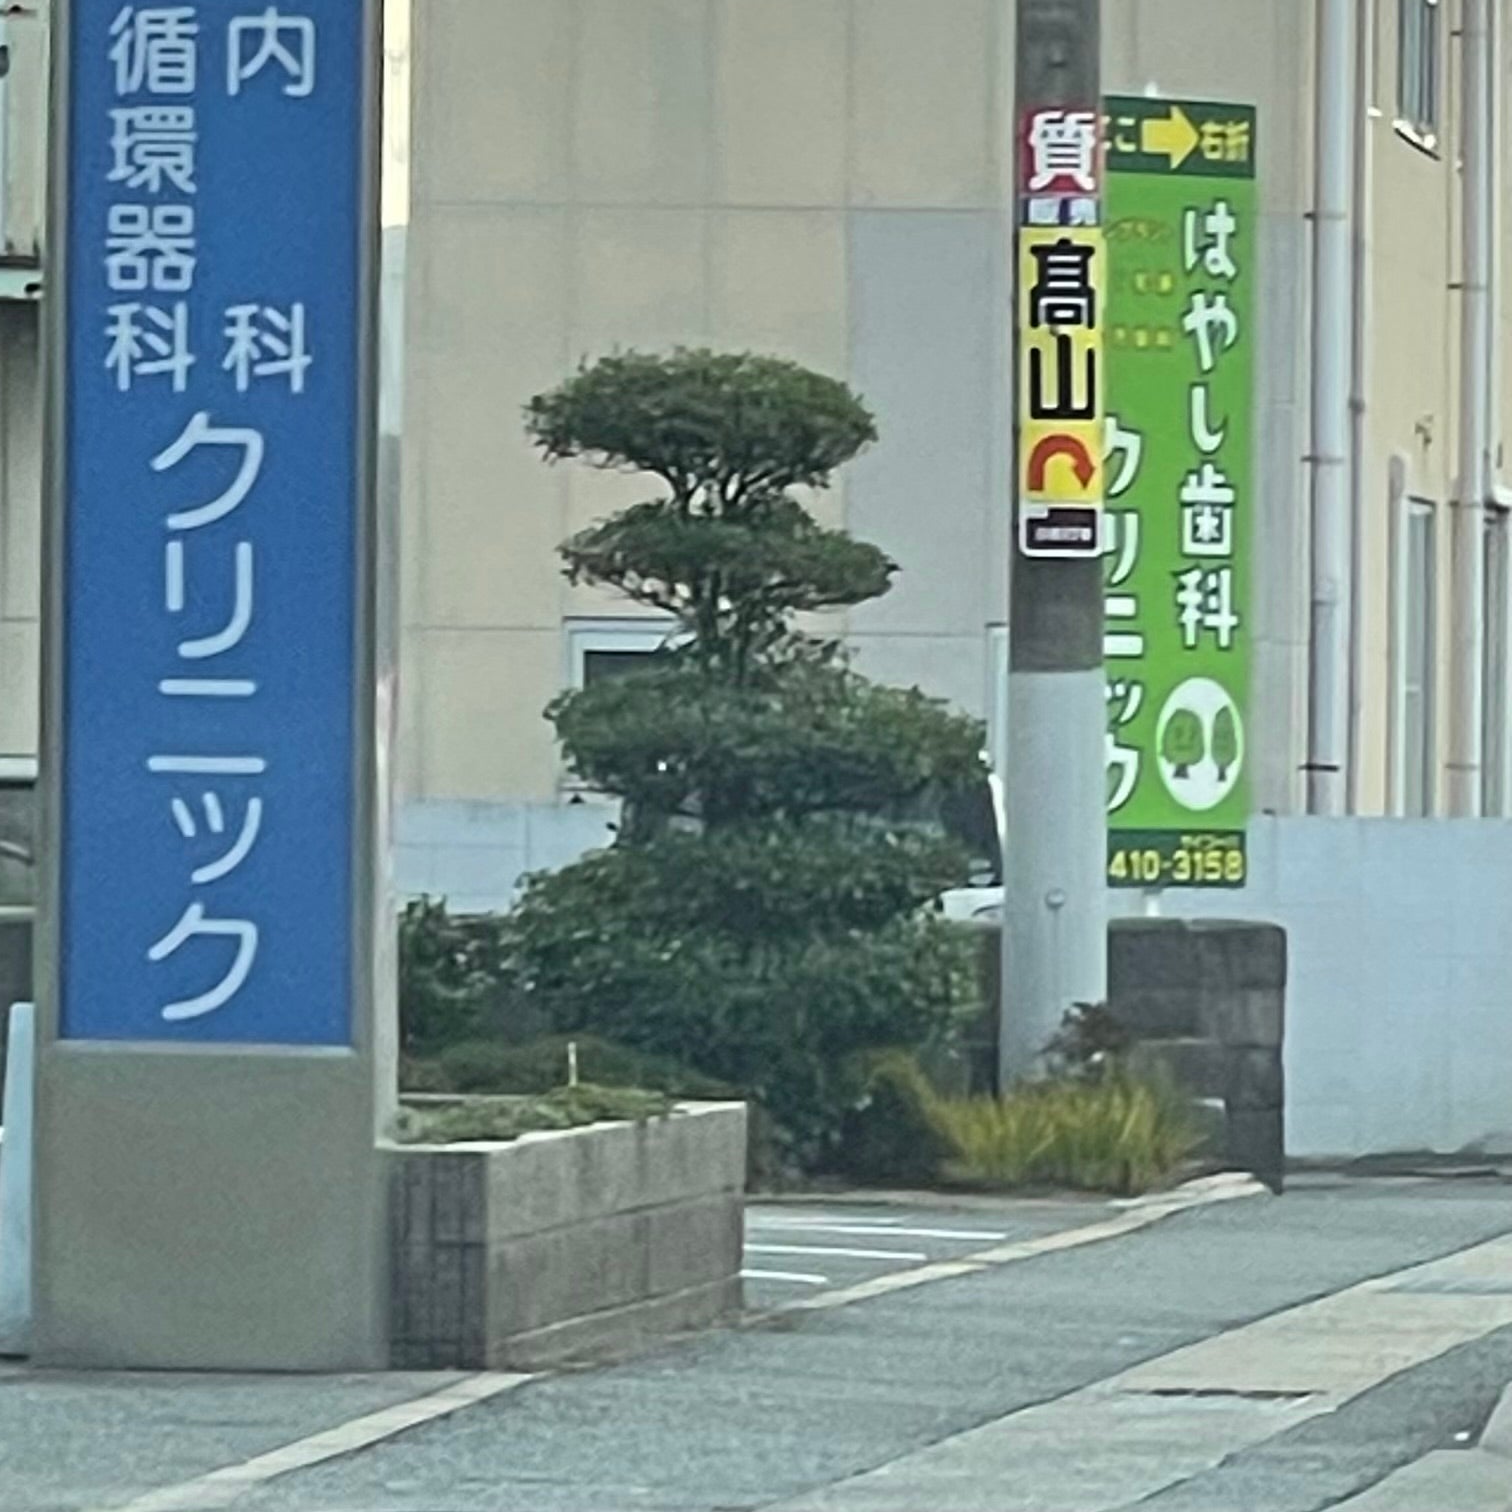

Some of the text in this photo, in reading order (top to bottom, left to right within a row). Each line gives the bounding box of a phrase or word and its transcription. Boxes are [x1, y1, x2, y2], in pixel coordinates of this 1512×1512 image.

[104, 5, 199, 393] 循環器科
[1028, 110, 1096, 191] 質
[1176, 201, 1239, 649] はやし歯科
[147, 411, 267, 1021] クリニック
